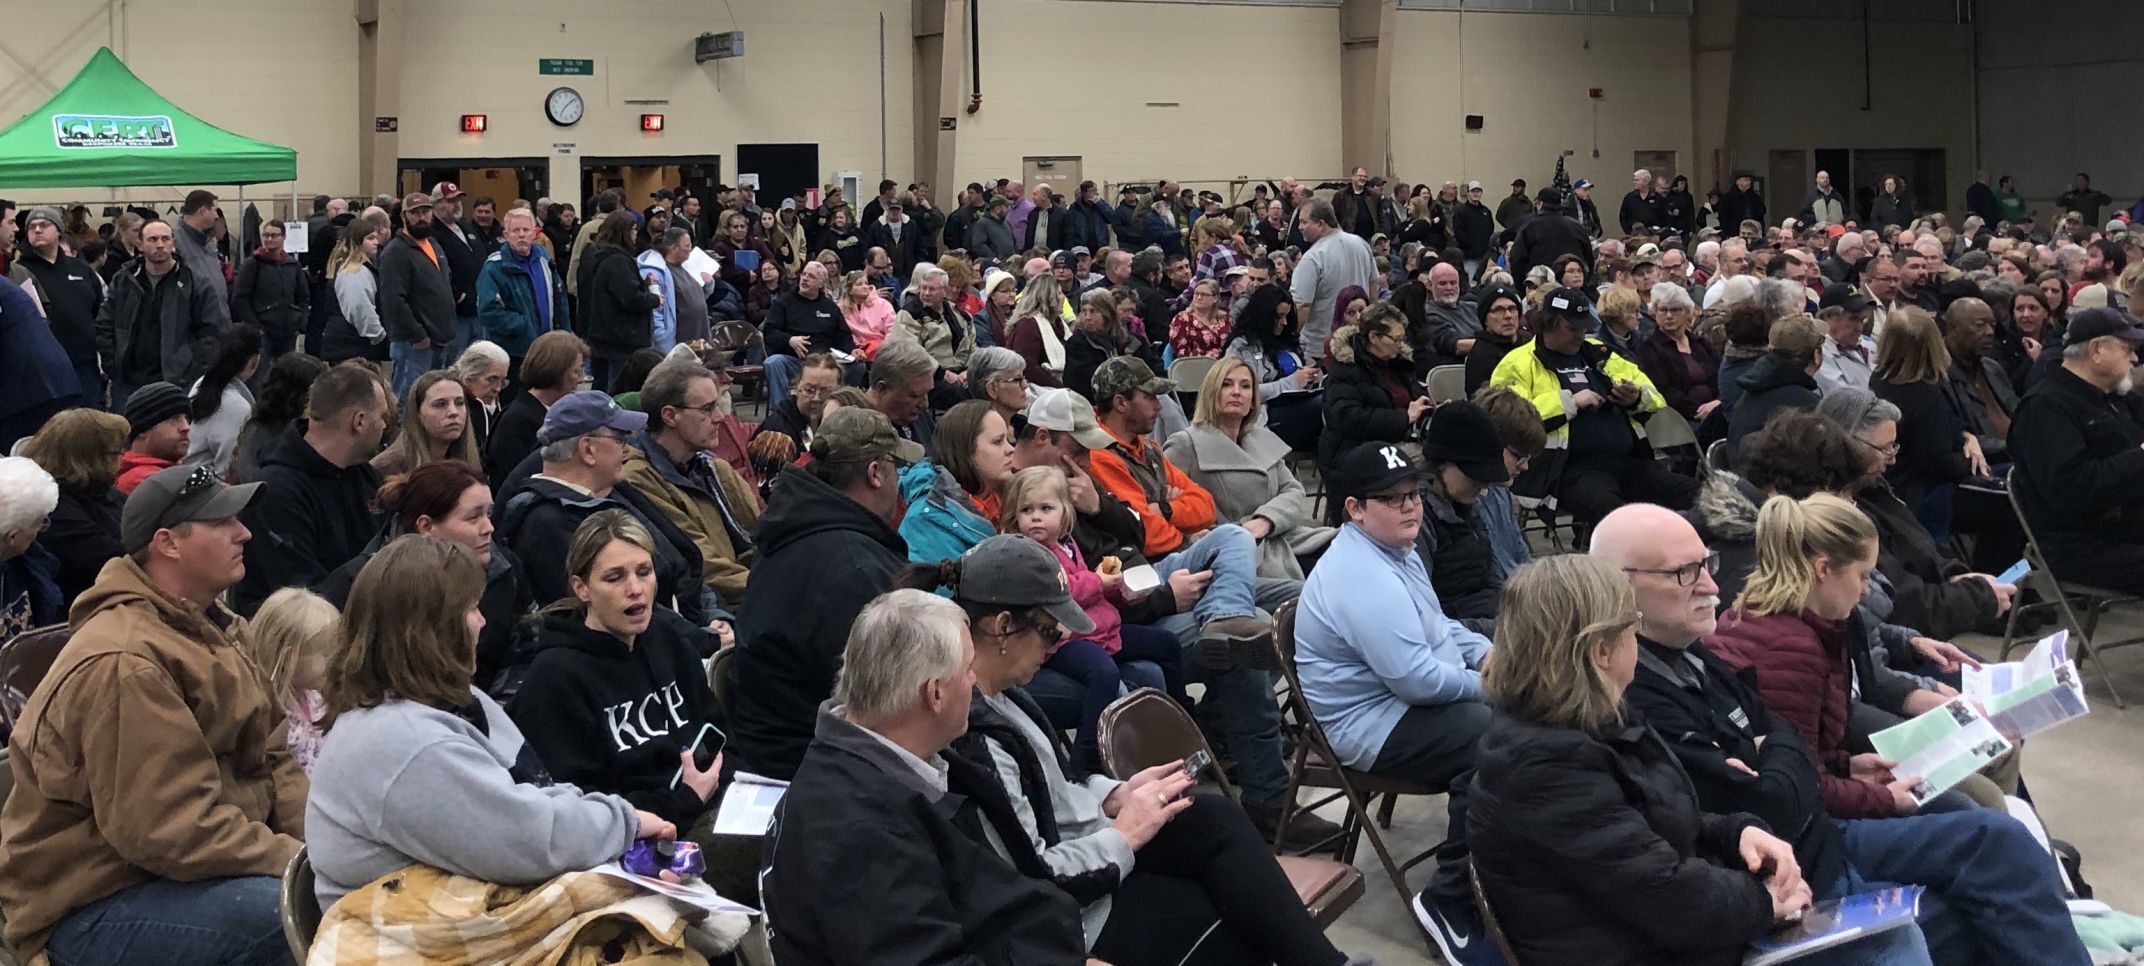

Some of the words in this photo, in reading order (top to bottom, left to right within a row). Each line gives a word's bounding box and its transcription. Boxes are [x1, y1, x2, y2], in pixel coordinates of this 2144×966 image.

[61, 118, 164, 139] CERT
[465, 116, 484, 130] EXIT
[645, 116, 662, 129] EXIT
[1379, 446, 1407, 469] K
[603, 681, 689, 752] KCP
